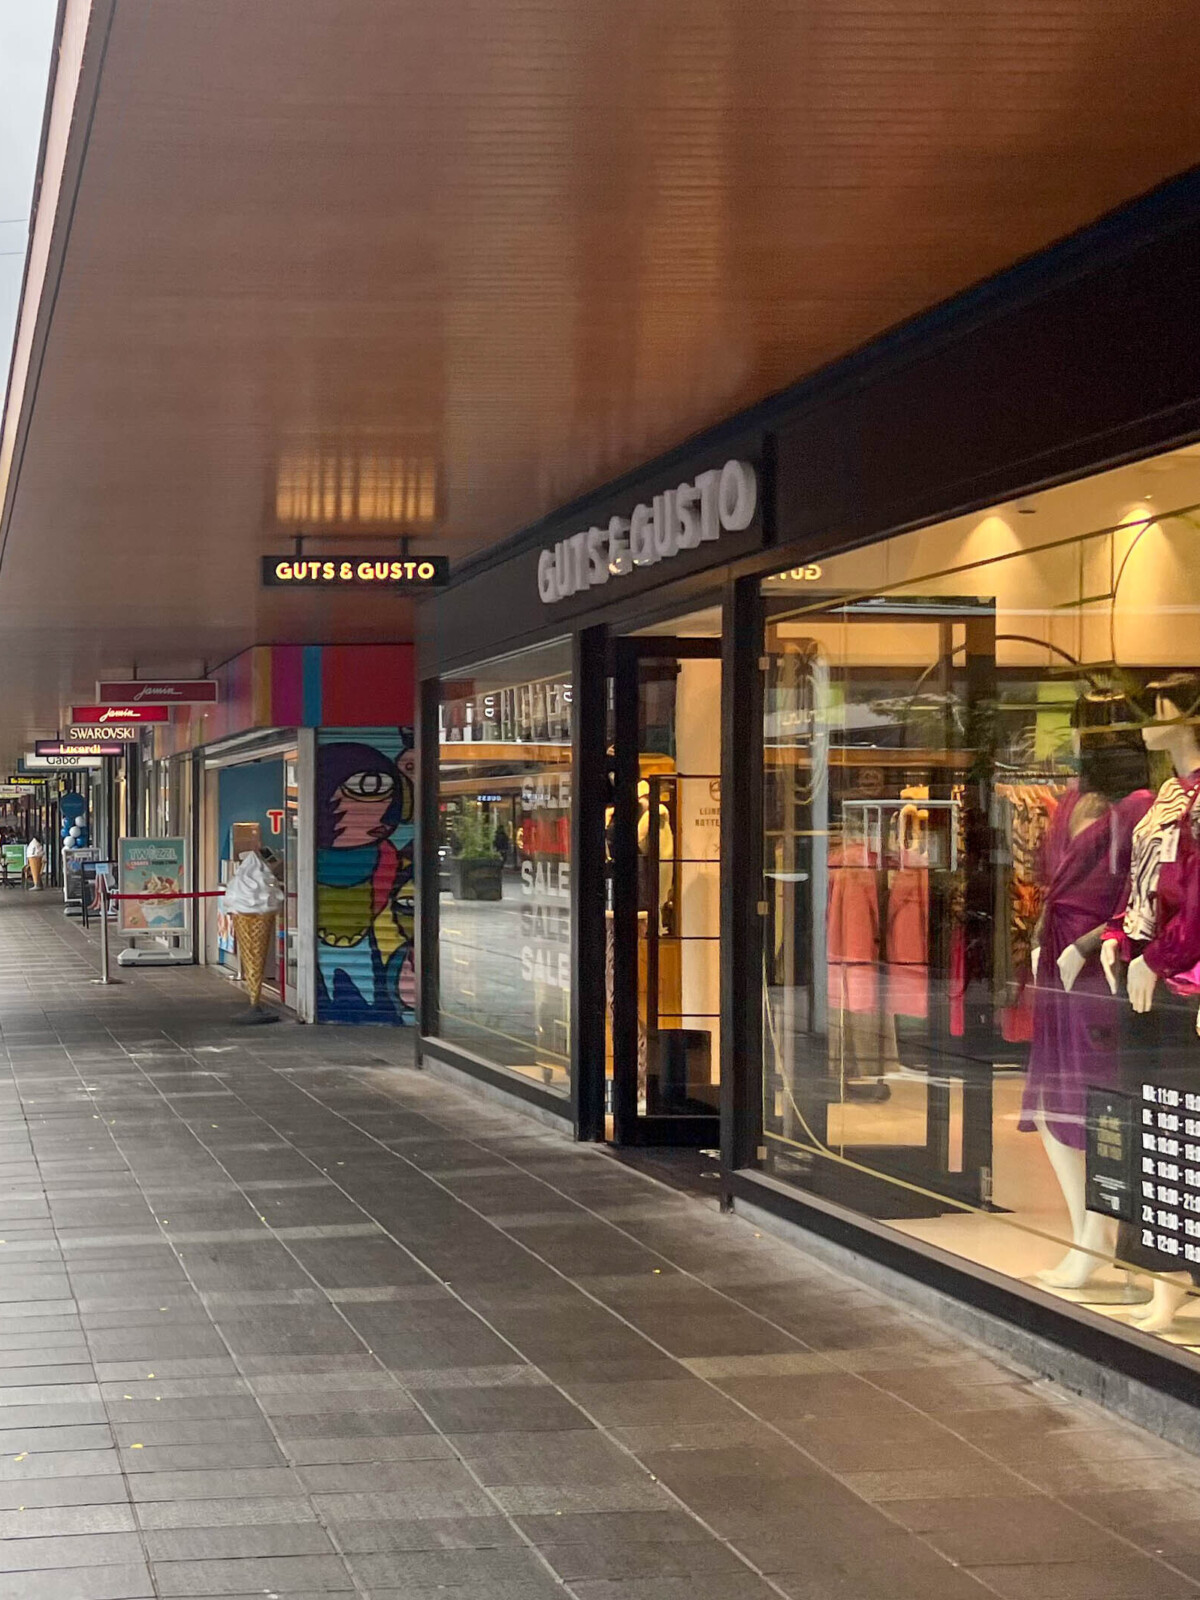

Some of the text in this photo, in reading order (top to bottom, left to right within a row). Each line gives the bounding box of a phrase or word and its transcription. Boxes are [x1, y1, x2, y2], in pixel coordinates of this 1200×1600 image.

[538, 459, 757, 604] GUTS & GUSTO
[275, 562, 435, 580] GUTS & GUSTO
[70, 727, 135, 740] SWAROVSKI
[46, 756, 80, 765] Gabor
[60, 744, 101, 755] Lucardi
[522, 774, 570, 811] SALE
[521, 861, 569, 897] SALE
[521, 945, 570, 988] SALE
